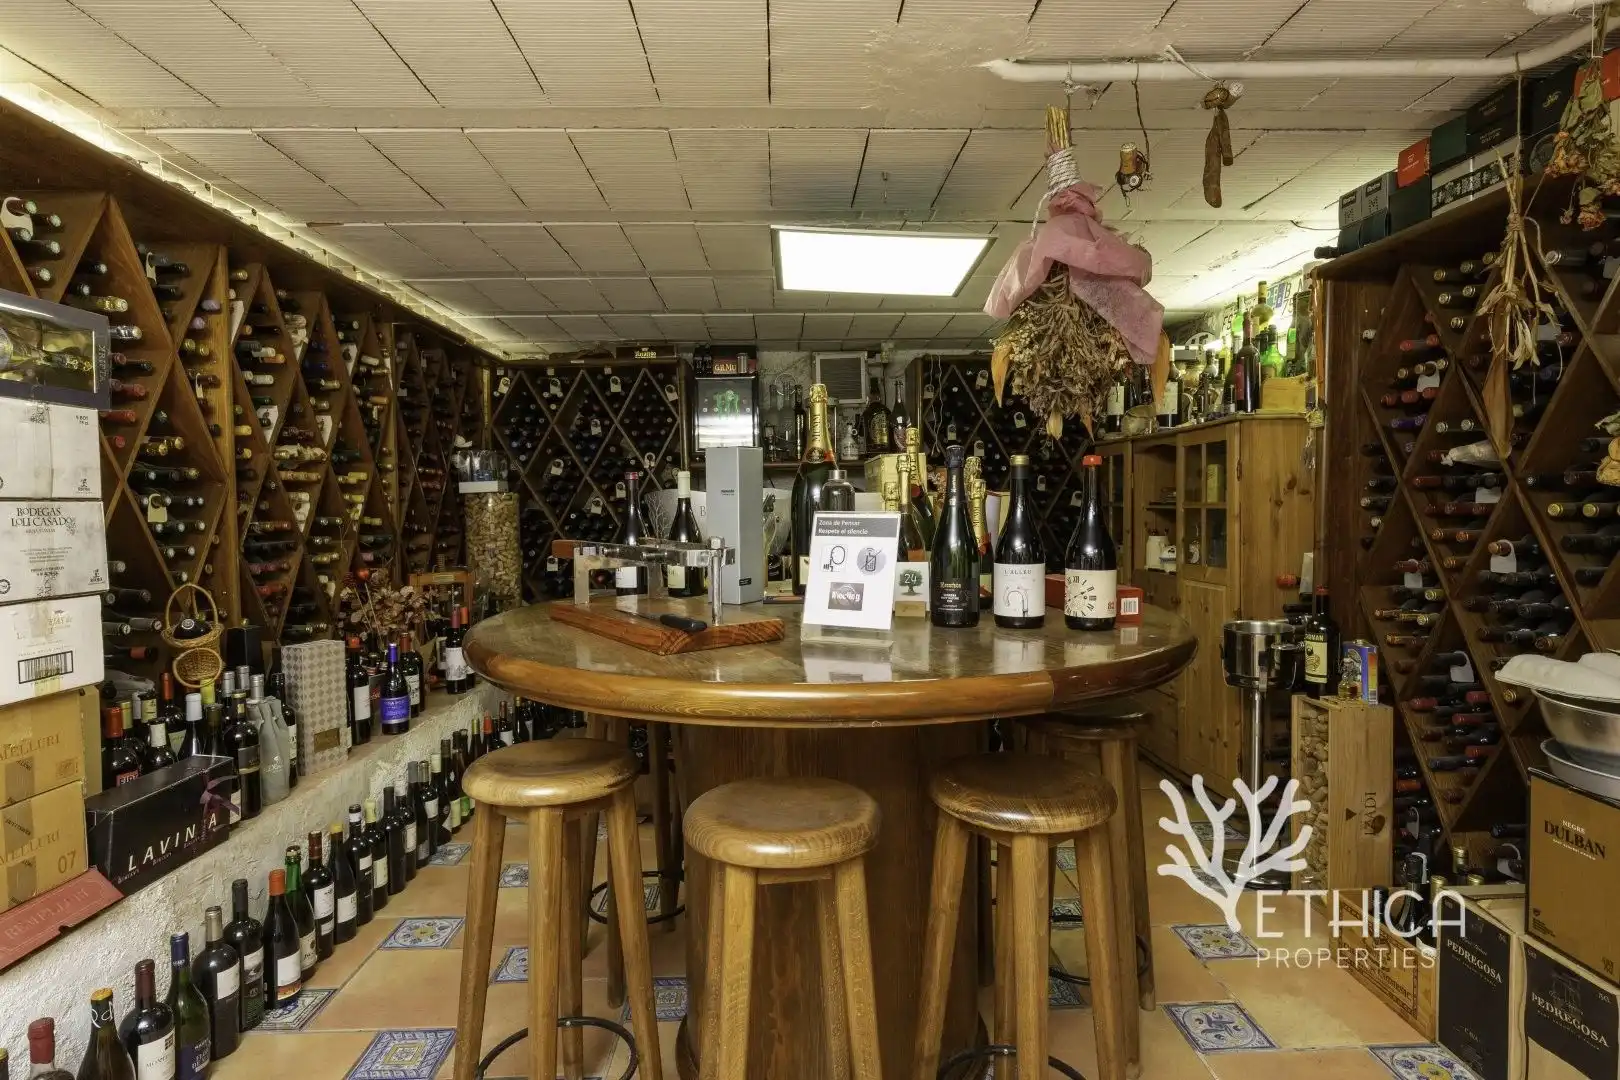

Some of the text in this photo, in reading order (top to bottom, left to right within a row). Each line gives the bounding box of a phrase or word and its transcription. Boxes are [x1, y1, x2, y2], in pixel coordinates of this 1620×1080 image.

[11, 518, 31, 527] LOLI
[16, 507, 62, 517] BODEGAS
[904, 573, 917, 585] 24
[1544, 820, 1607, 860] DULBAN
[1562, 819, 1586, 835] NEGRE
[128, 812, 218, 873] LAVINA
[58, 847, 77, 875] 07
[1447, 939, 1503, 984] PEDREGOSA
[1531, 991, 1610, 1048] PEDREGOSA
